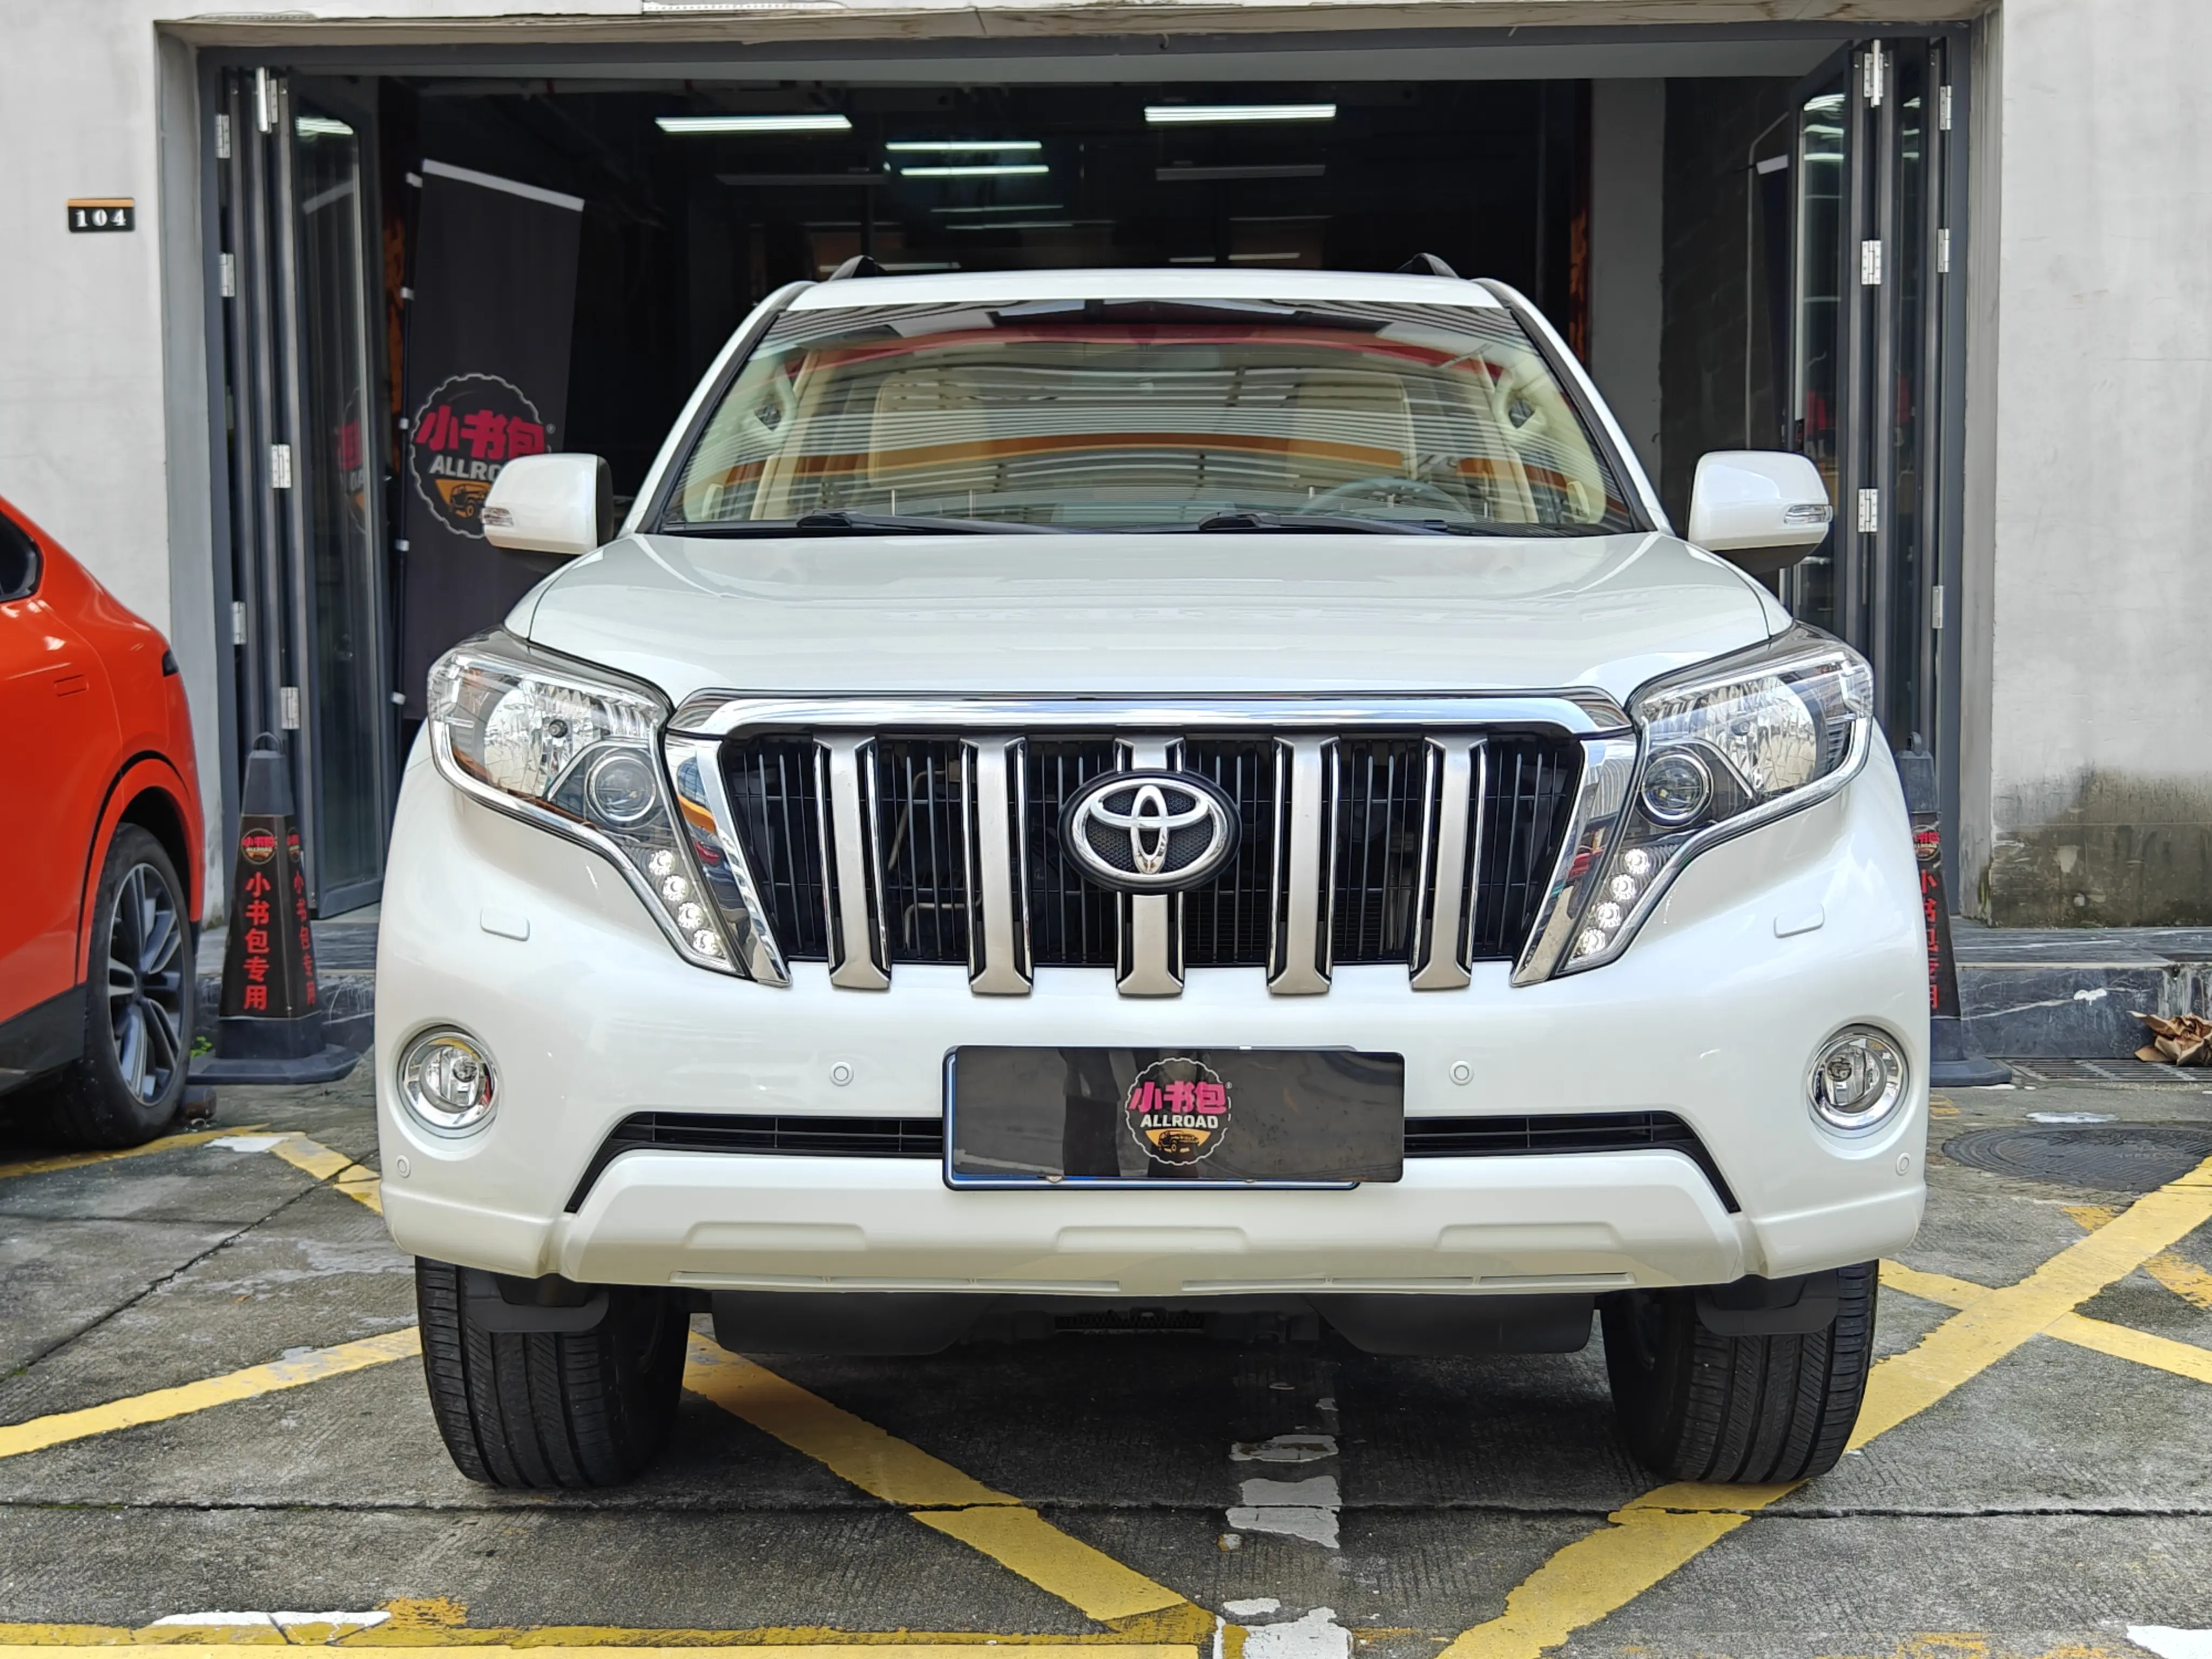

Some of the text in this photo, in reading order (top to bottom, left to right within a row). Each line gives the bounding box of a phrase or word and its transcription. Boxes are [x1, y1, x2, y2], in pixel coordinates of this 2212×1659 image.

[75, 208, 126, 227] 104
[415, 405, 545, 459] 小书包
[429, 454, 503, 481] ALLRO
[243, 871, 271, 1010] 小书包专用
[1128, 1081, 1227, 1114] 小书包
[1140, 1114, 1218, 1128] ALLROAD
